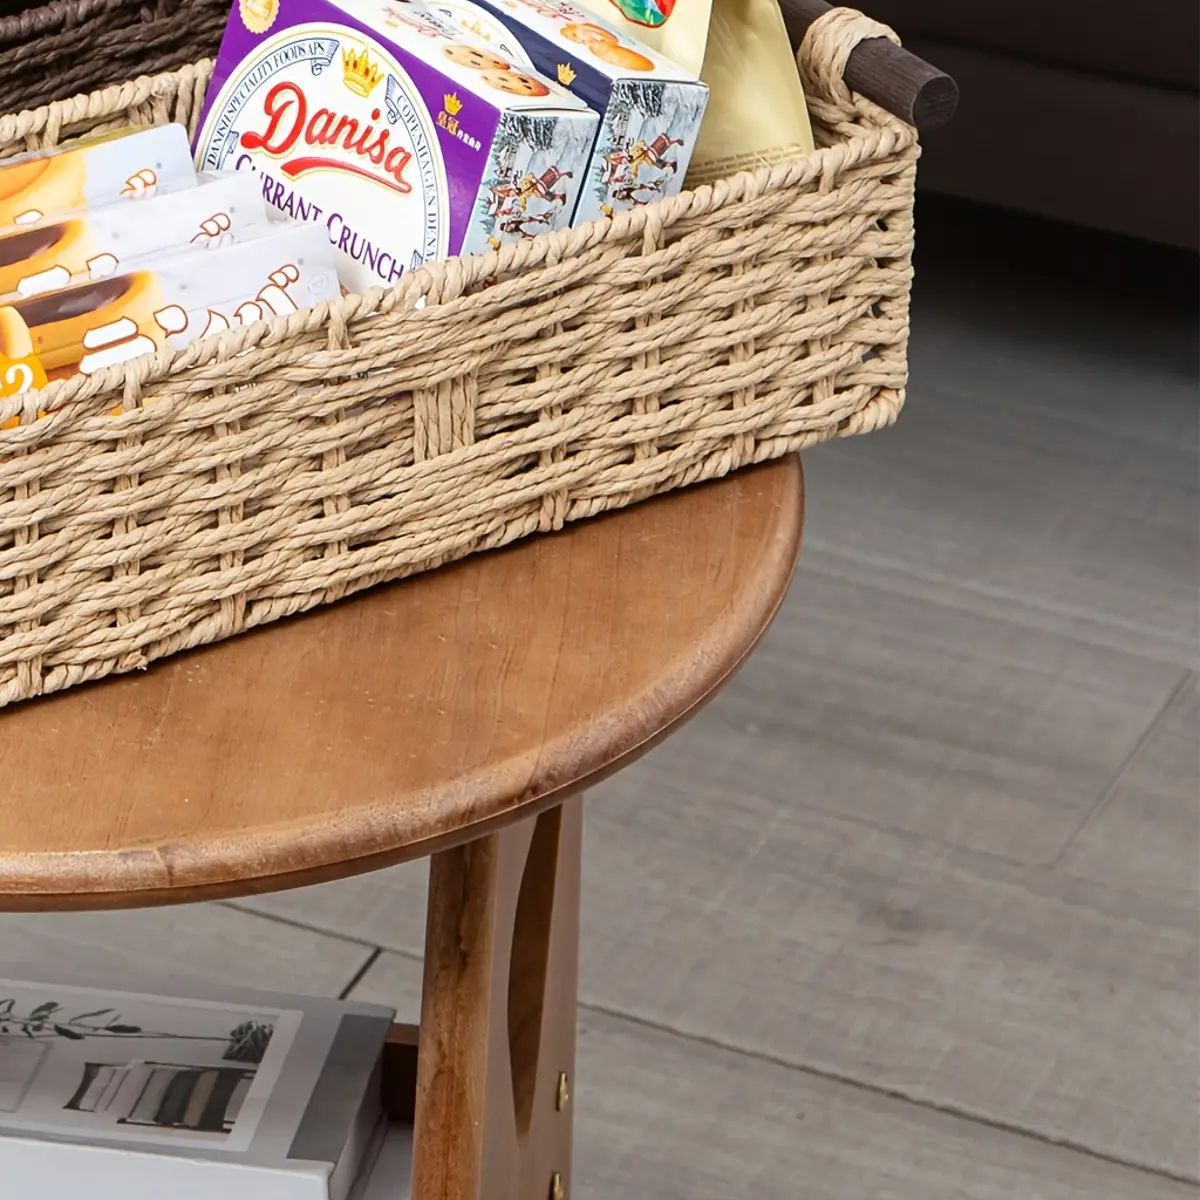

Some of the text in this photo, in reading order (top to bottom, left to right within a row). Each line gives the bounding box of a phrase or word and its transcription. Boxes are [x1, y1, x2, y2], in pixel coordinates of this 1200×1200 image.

[207, 113, 233, 166] DANISH
[240, 81, 413, 194] Danisa
[397, 95, 437, 206] COPENHAGEN
[326, 212, 405, 284] CRUNCH
